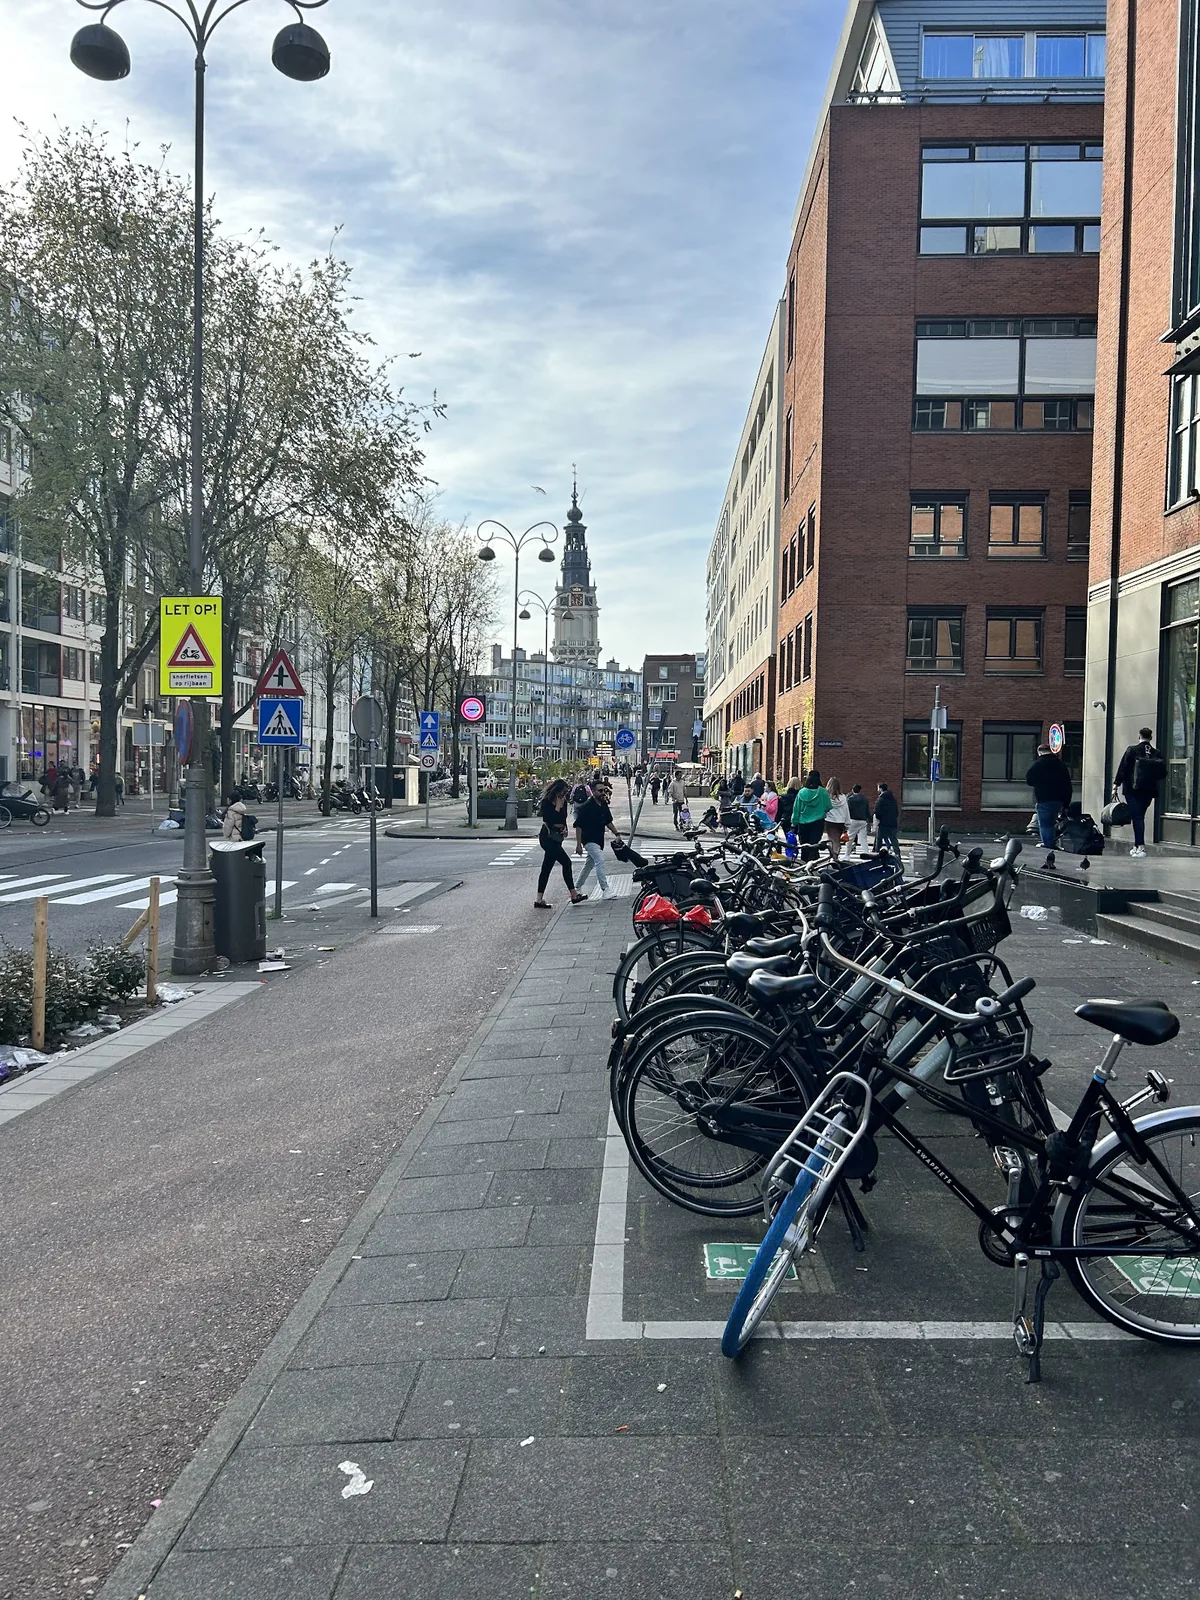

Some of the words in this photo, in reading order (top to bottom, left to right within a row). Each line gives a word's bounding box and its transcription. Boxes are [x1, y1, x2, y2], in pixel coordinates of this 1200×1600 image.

[165, 604, 190, 615] LET
[194, 604, 217, 615] OP!
[916, 1149, 952, 1184] SWAPFIETS
